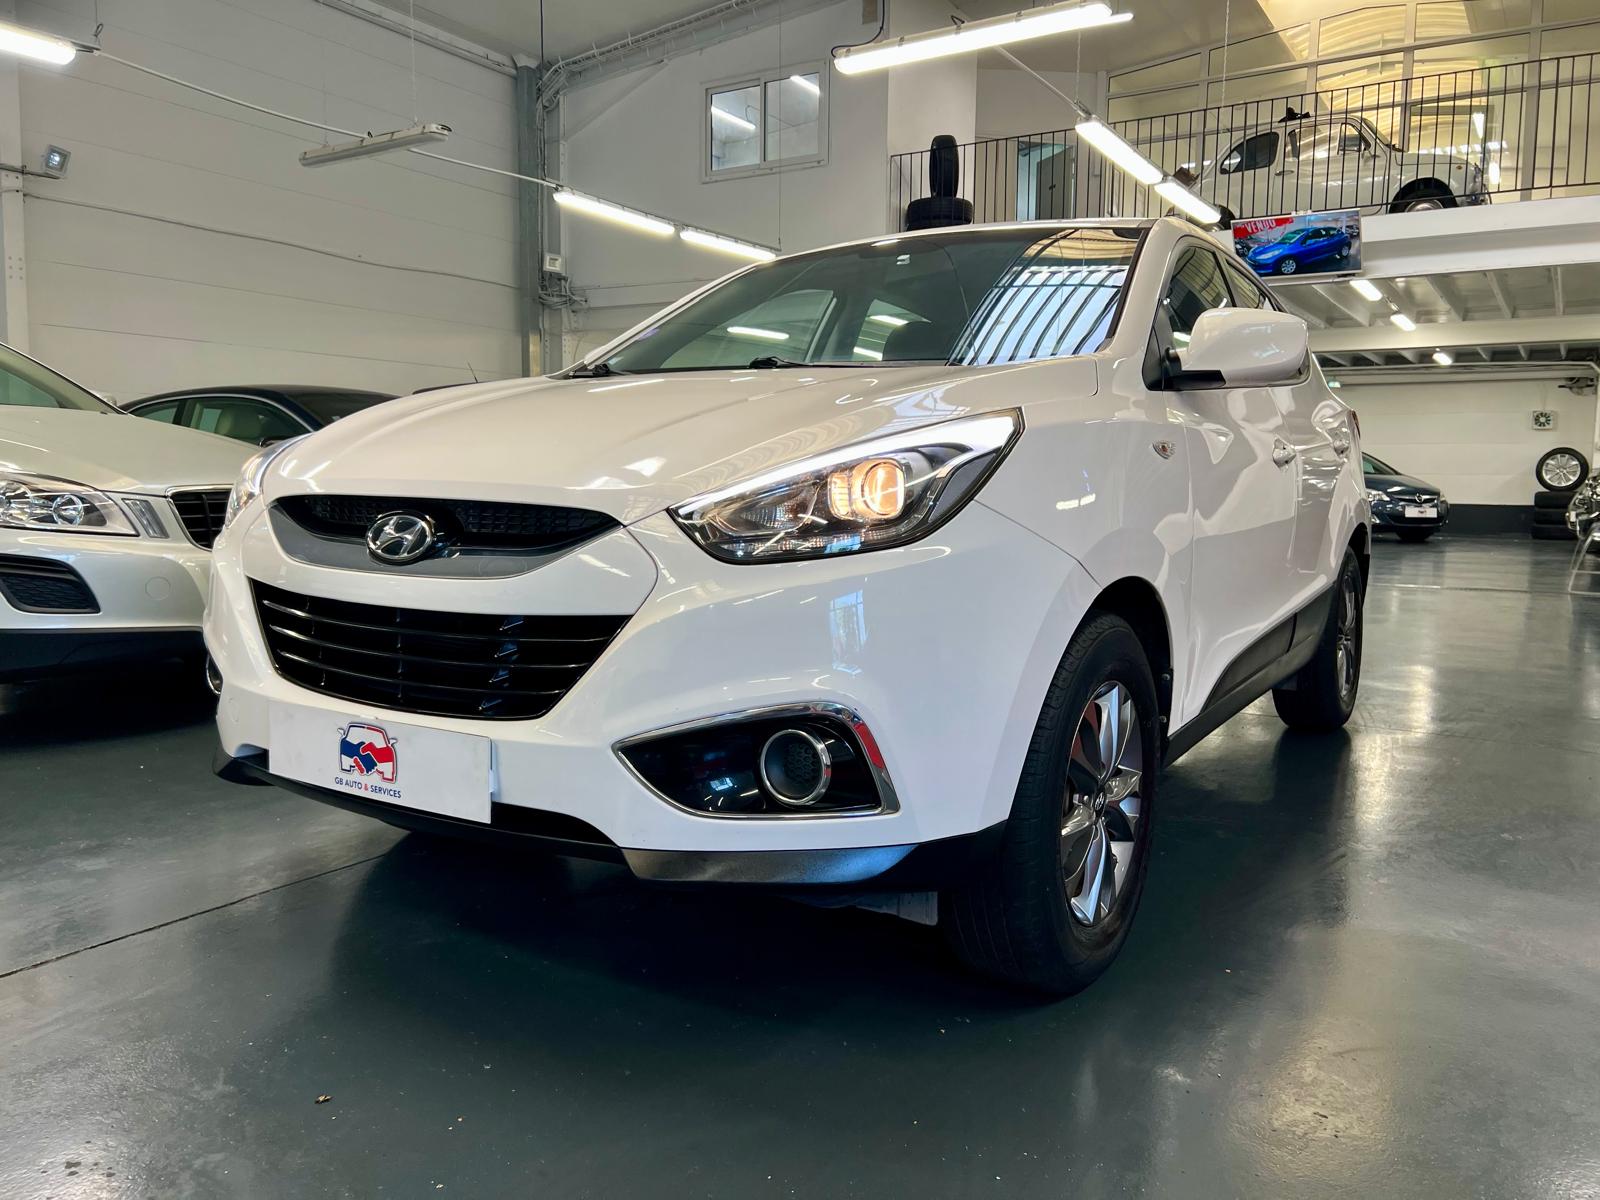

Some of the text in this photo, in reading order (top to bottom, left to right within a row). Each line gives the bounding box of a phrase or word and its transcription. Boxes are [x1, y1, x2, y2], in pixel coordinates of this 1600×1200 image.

[334, 777, 402, 799] GB AUTO & SERVICES
